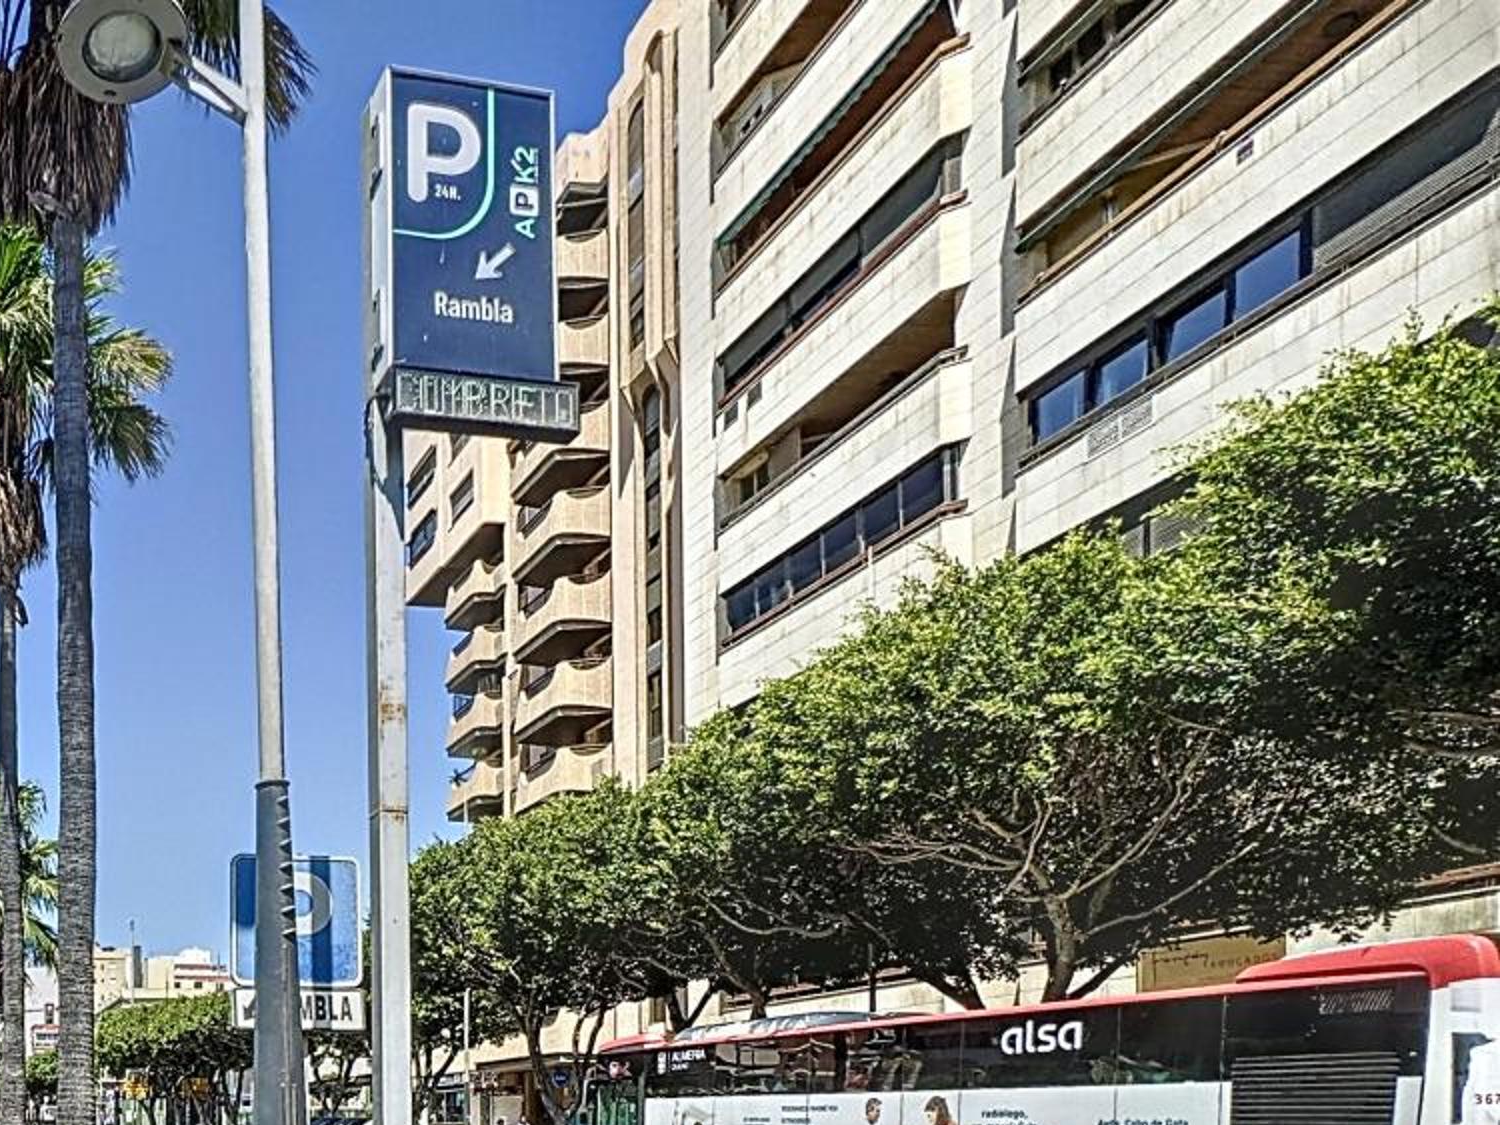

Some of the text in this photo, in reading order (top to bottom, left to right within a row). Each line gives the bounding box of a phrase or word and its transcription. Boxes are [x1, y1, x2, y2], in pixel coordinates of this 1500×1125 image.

[407, 103, 481, 202] P
[434, 290, 514, 324] Rambla
[1001, 1019, 1084, 1055] alsa
